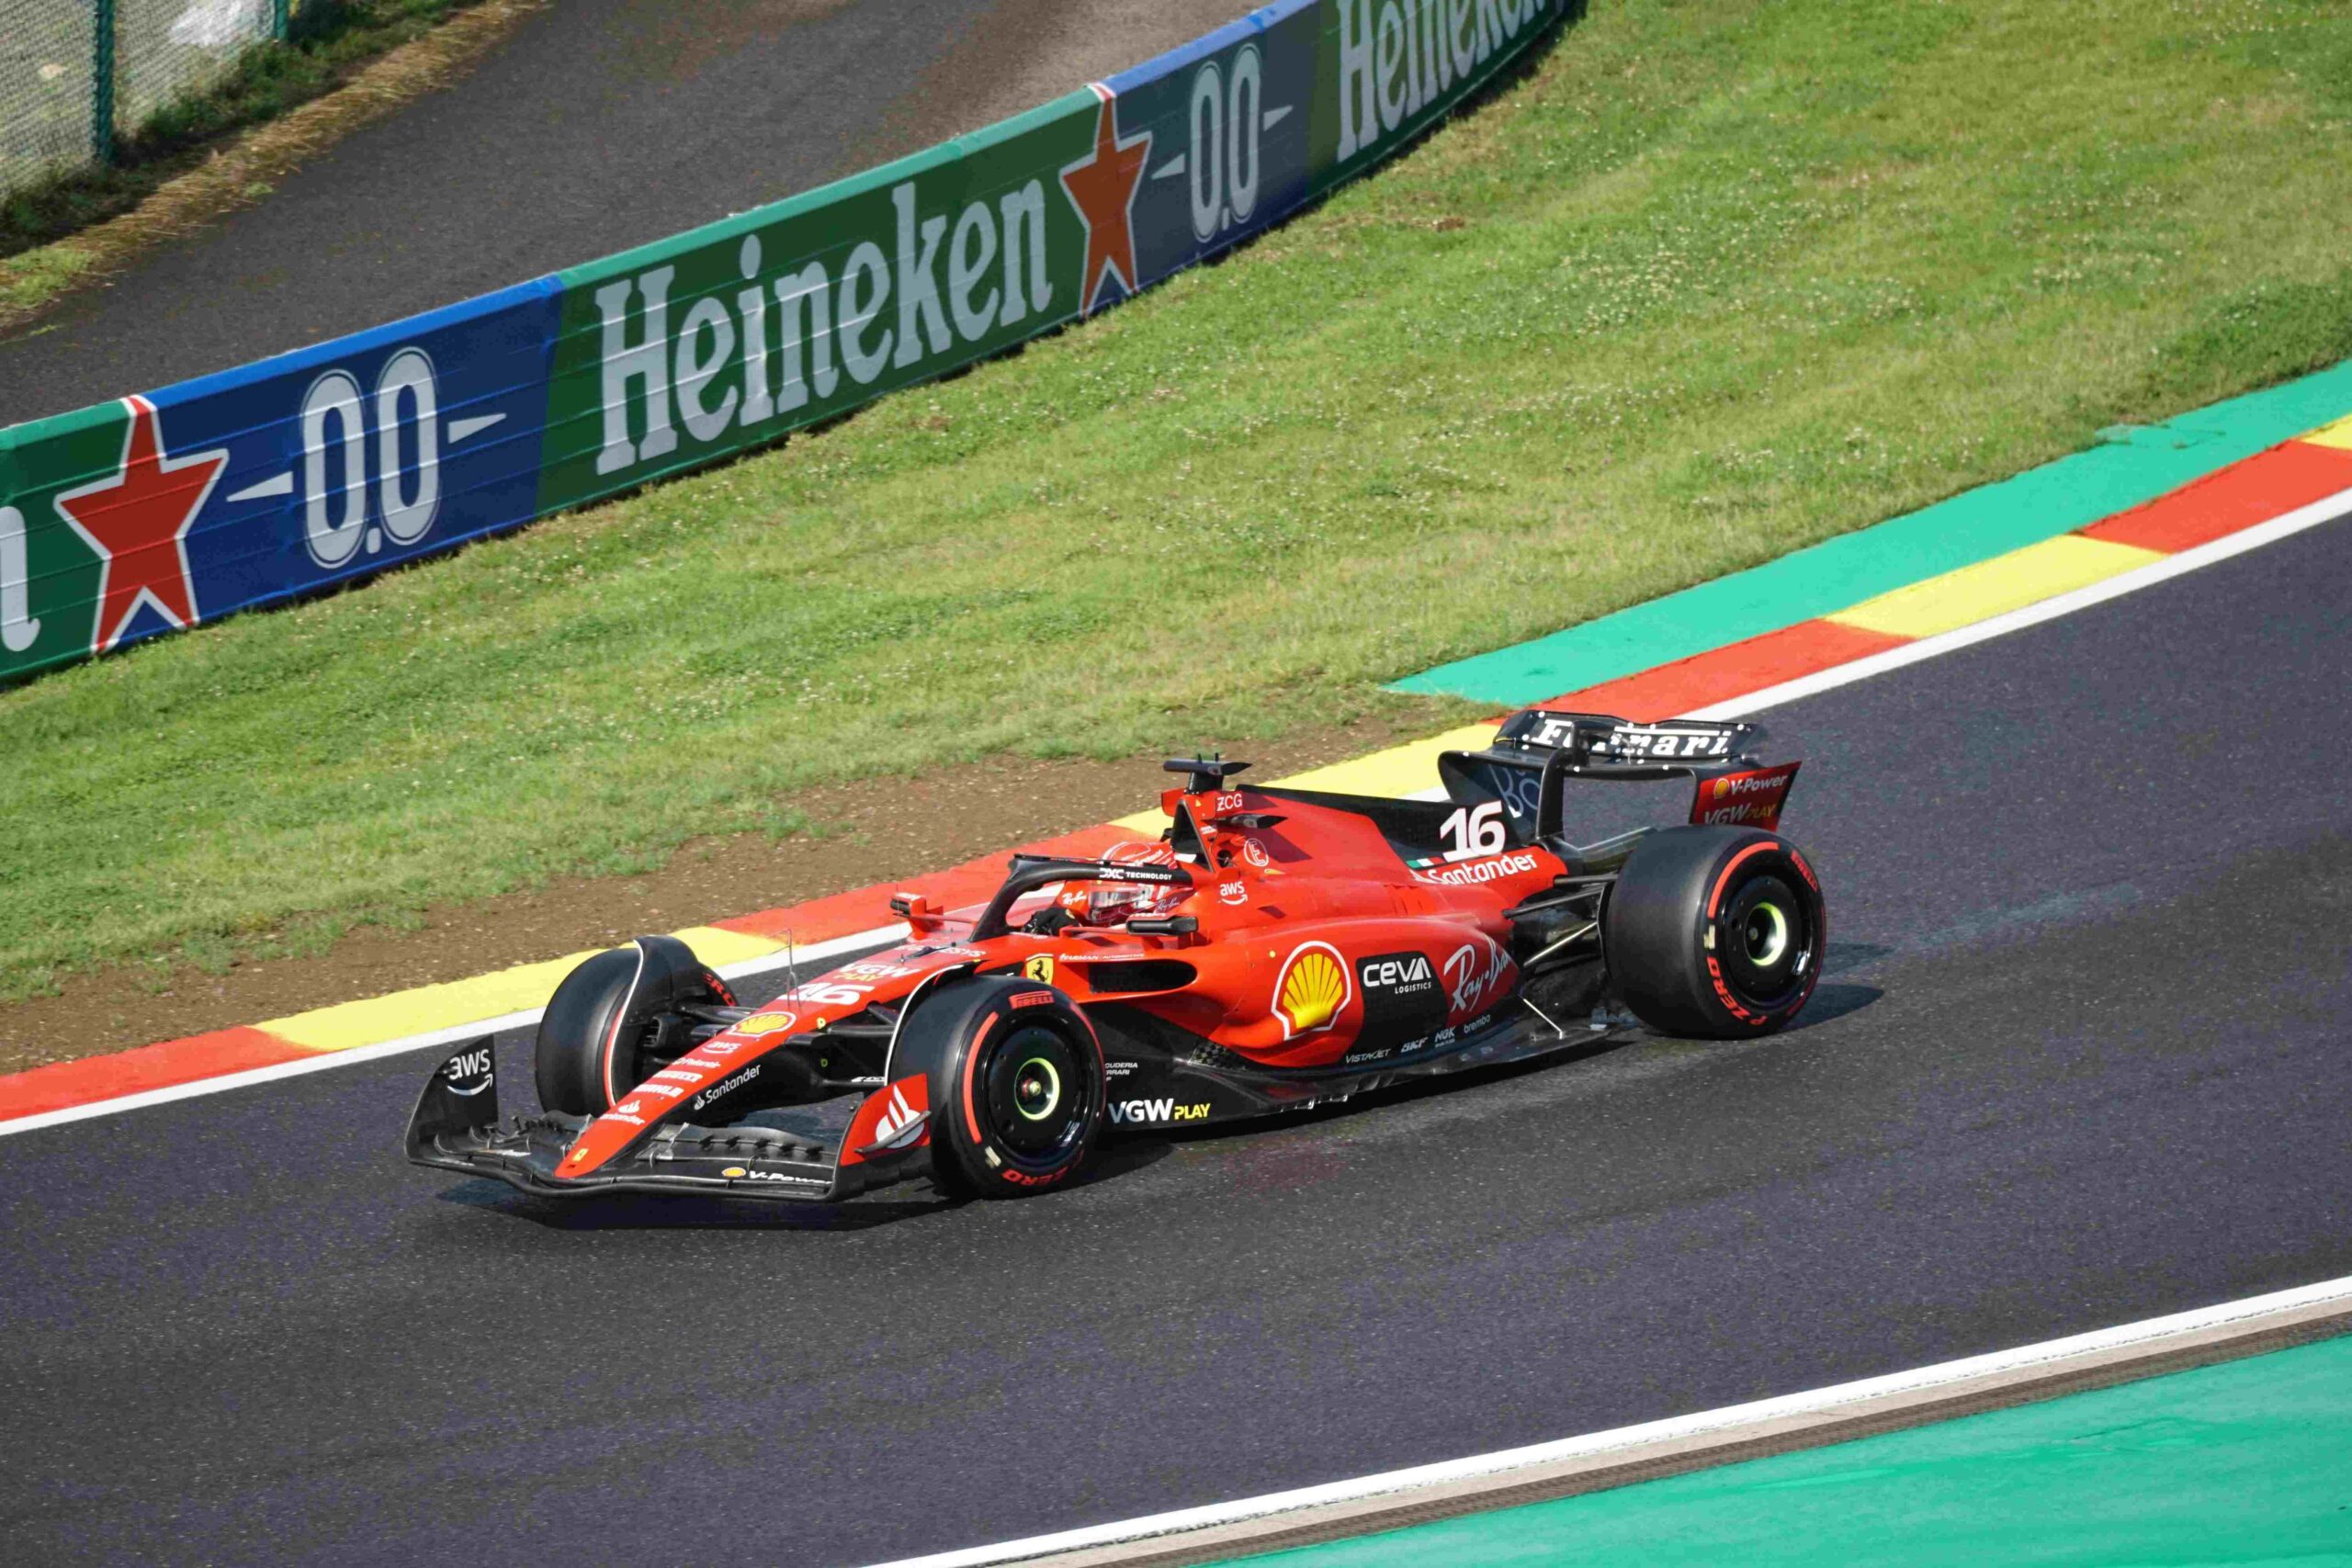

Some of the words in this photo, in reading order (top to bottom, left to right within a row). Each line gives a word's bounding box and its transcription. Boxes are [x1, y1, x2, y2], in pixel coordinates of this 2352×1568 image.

[1337, 0, 1547, 163] Heine
[1191, 43, 1261, 243] 0.0
[596, 178, 1053, 475] Heineken
[300, 346, 441, 569] 0.0
[1731, 775, 1788, 795] V-Power
[1704, 803, 1751, 824] VGW
[1440, 800, 1506, 863] 16
[1126, 873, 1172, 881] TECHNOLOGY
[1428, 853, 1537, 885] Santander
[1220, 881, 1245, 897] aws
[776, 982, 875, 1005] 16
[1395, 982, 1431, 994] LOGISTICS
[1434, 1026, 1456, 1043] NGK
[1464, 1014, 1490, 1033] brembo
[449, 1048, 491, 1080] aws
[706, 1064, 761, 1104] Santander
[1108, 1098, 1174, 1124] VGW
[1174, 1103, 1211, 1120] PLAY
